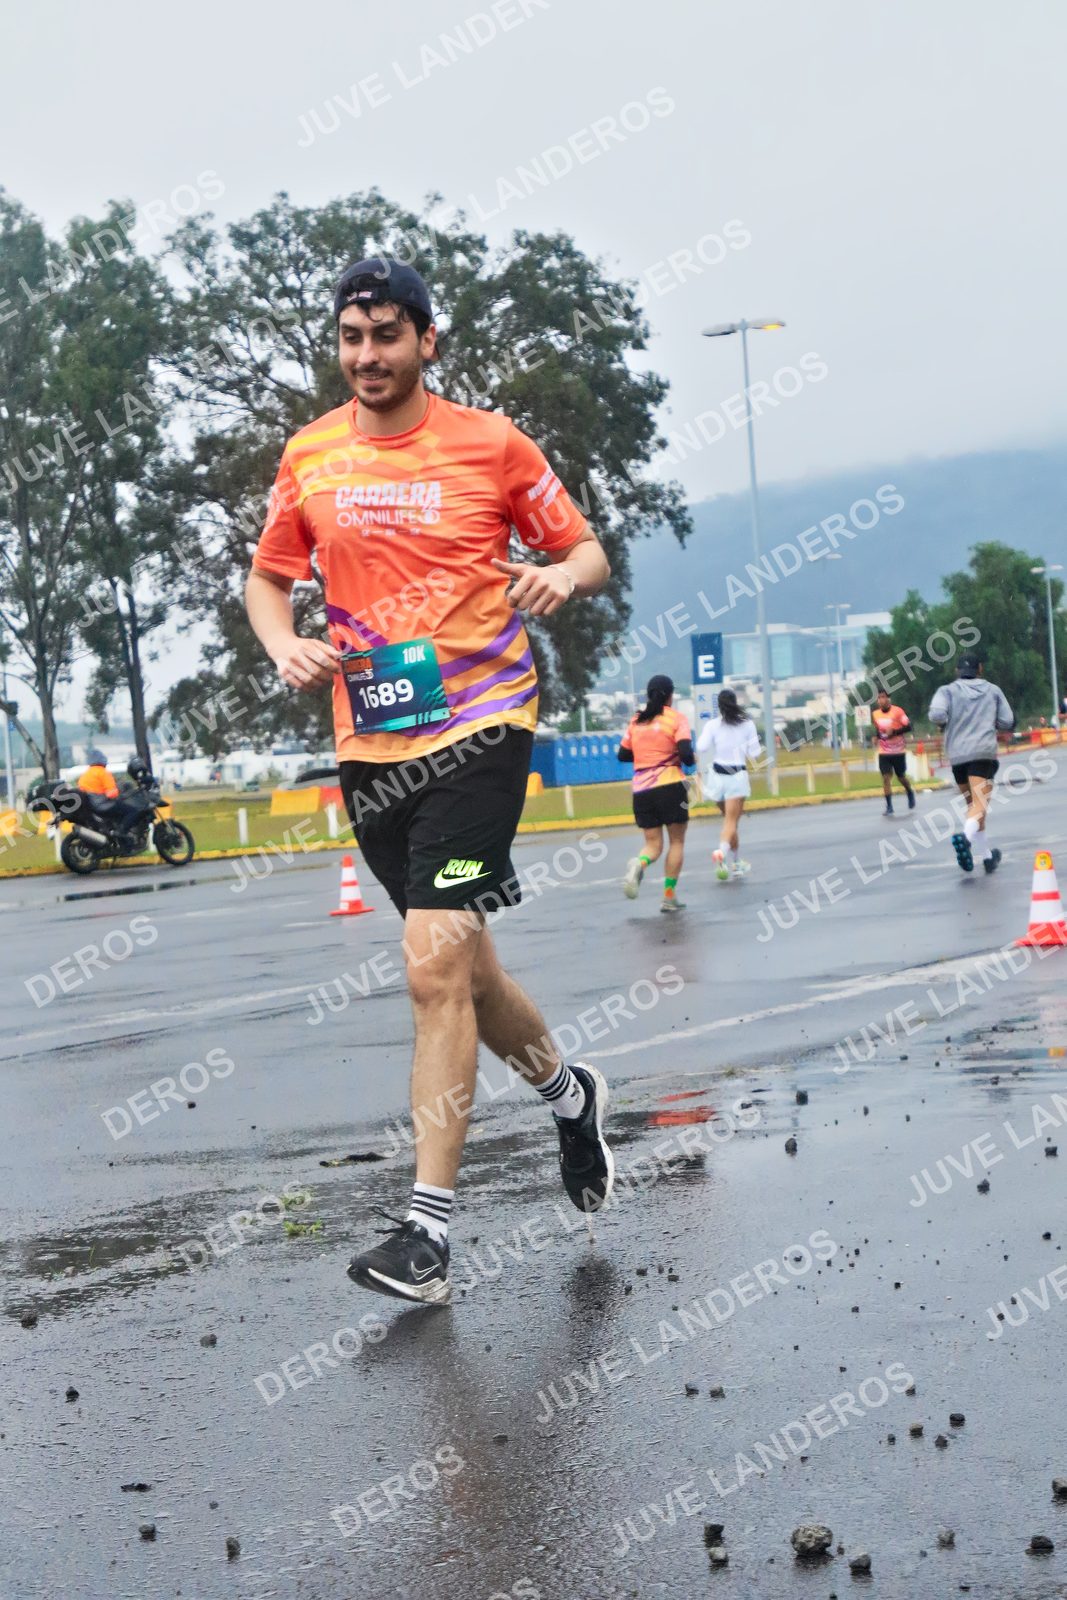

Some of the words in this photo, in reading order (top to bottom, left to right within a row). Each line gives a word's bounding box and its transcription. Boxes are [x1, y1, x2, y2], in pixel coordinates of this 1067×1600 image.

[336, 481, 442, 508] CARRERA
[336, 509, 417, 527] OMNILIFE
[402, 644, 426, 664] 10K
[697, 654, 716, 678] E
[358, 678, 414, 709] 1689
[443, 858, 484, 877] RUN
